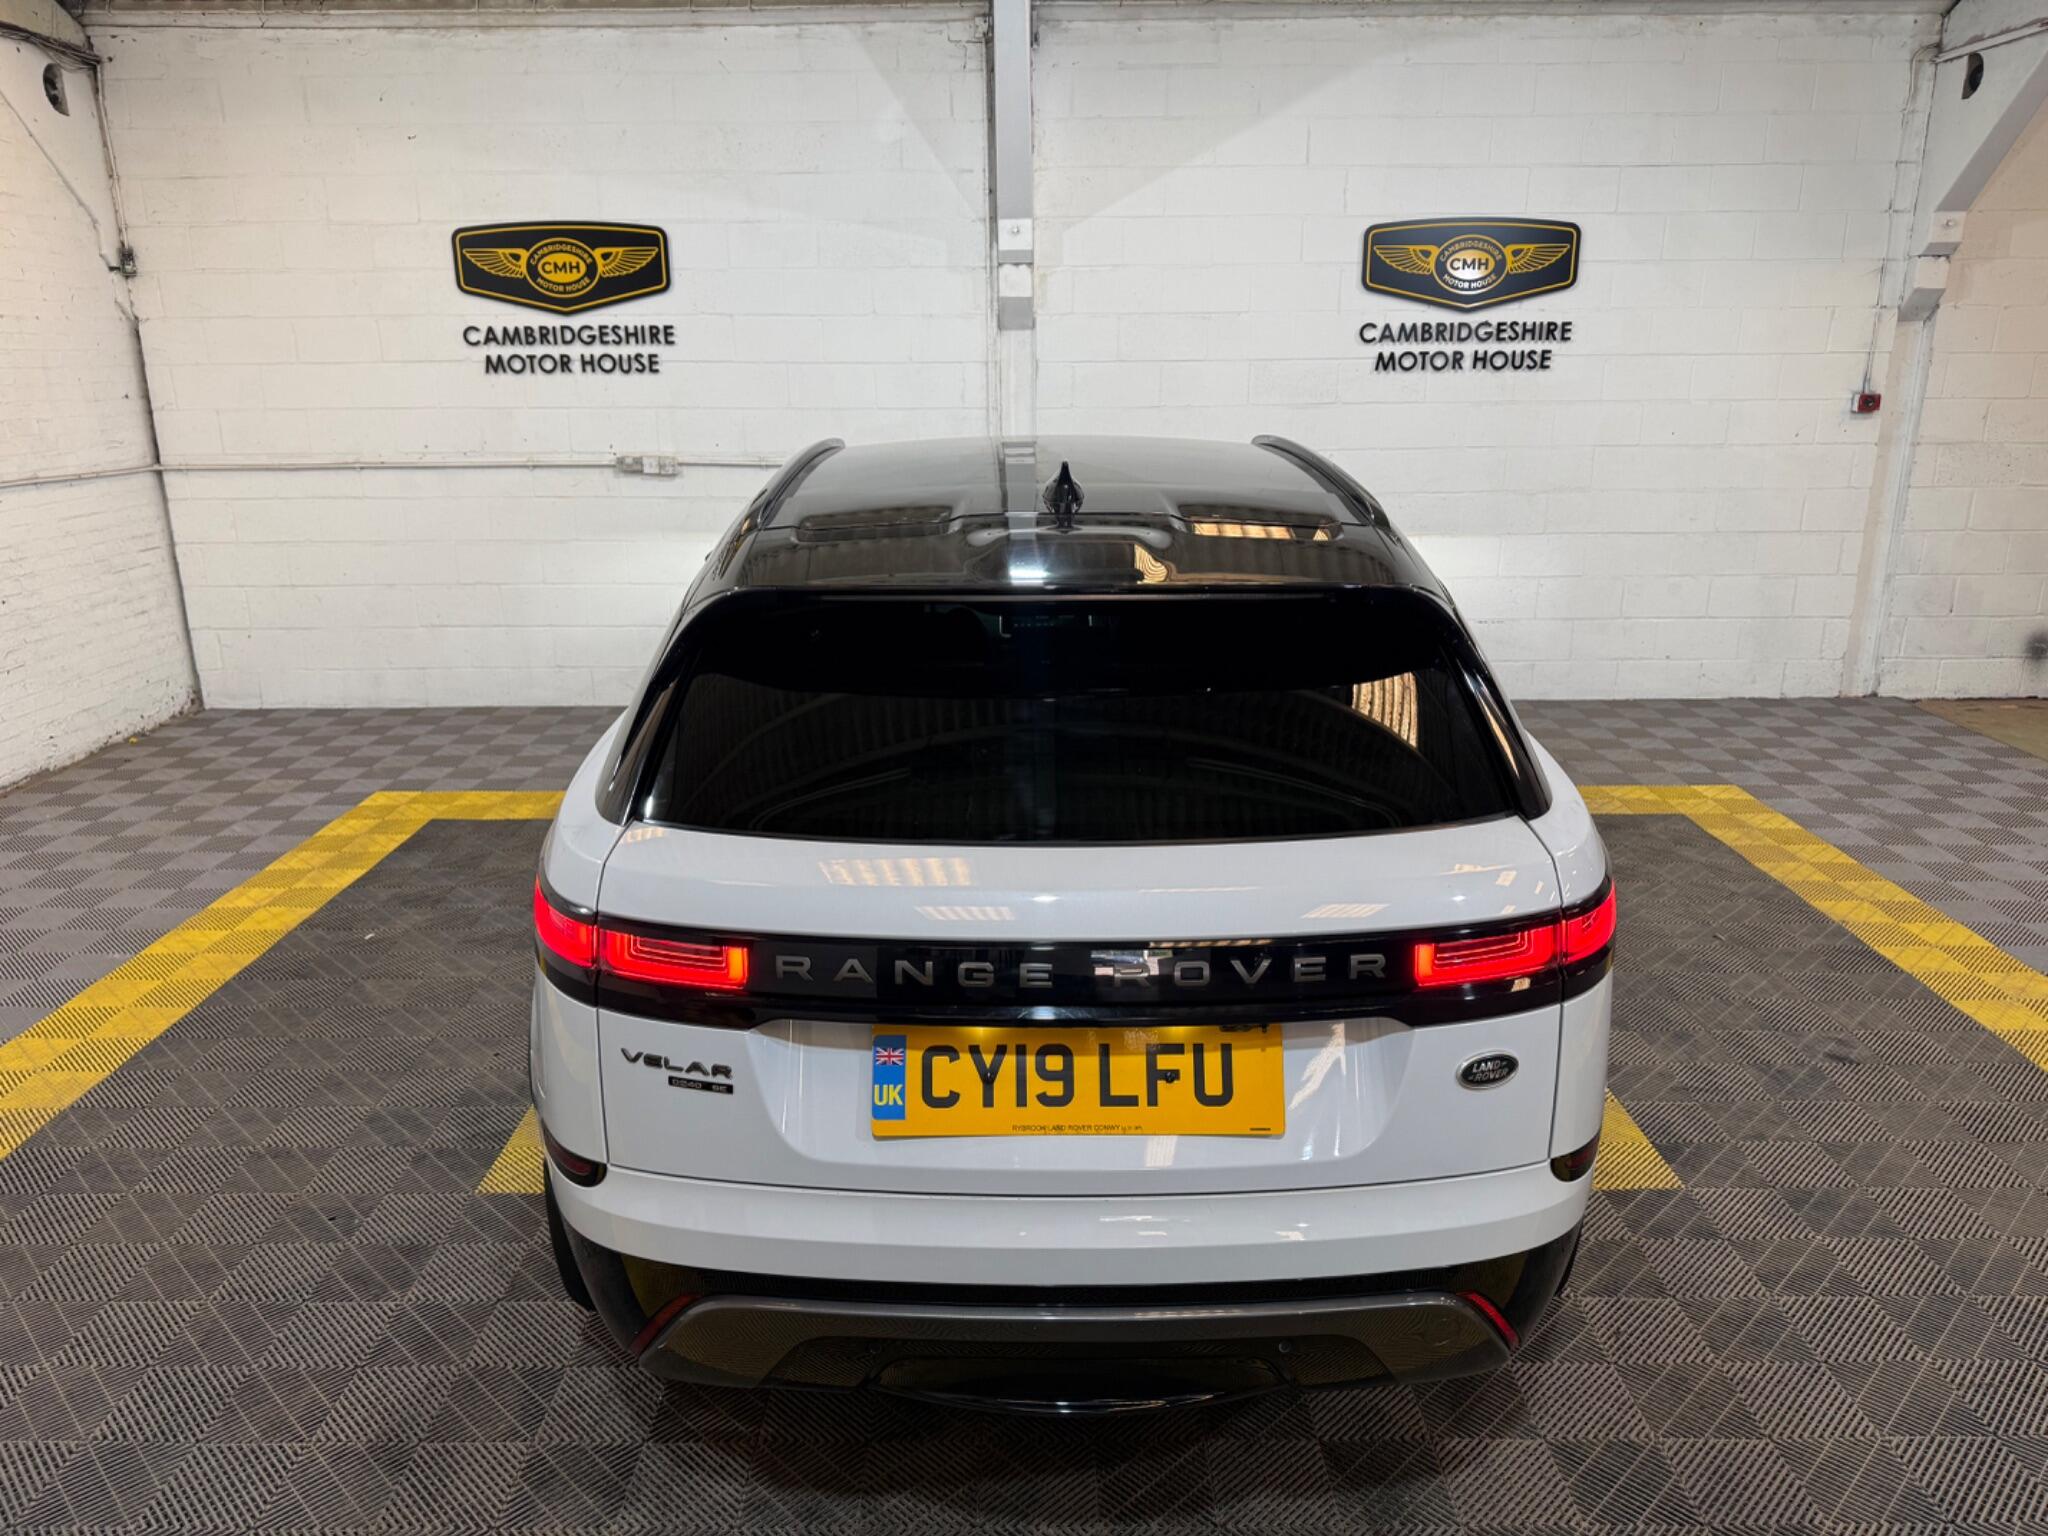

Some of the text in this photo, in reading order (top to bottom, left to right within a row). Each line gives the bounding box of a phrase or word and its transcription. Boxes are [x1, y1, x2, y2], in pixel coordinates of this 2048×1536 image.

[530, 244, 593, 265] CAMBRIDGESHIRE
[1440, 240, 1502, 262] CAMBRIDGESHIRE
[541, 261, 581, 274] CMH
[1449, 257, 1490, 271] CMH
[536, 277, 591, 292] MOTOR HOUSE
[1443, 273, 1497, 289] MOTOR HOUSE
[463, 325, 675, 347] CAMBRIDGESHIRE
[1359, 321, 1573, 344] CAMBRIDGESHIRE
[485, 354, 660, 374] MOTOR HOUSE
[1375, 350, 1552, 372] MOTOR HOUSE
[775, 952, 1388, 989] RANGE ROVER
[620, 1047, 733, 1080] VELAR
[1472, 1061, 1501, 1072] LAND
[921, 1043, 1234, 1109] CY19 LFU
[1474, 1070, 1507, 1081] ROVER
[873, 1084, 904, 1106] UK
